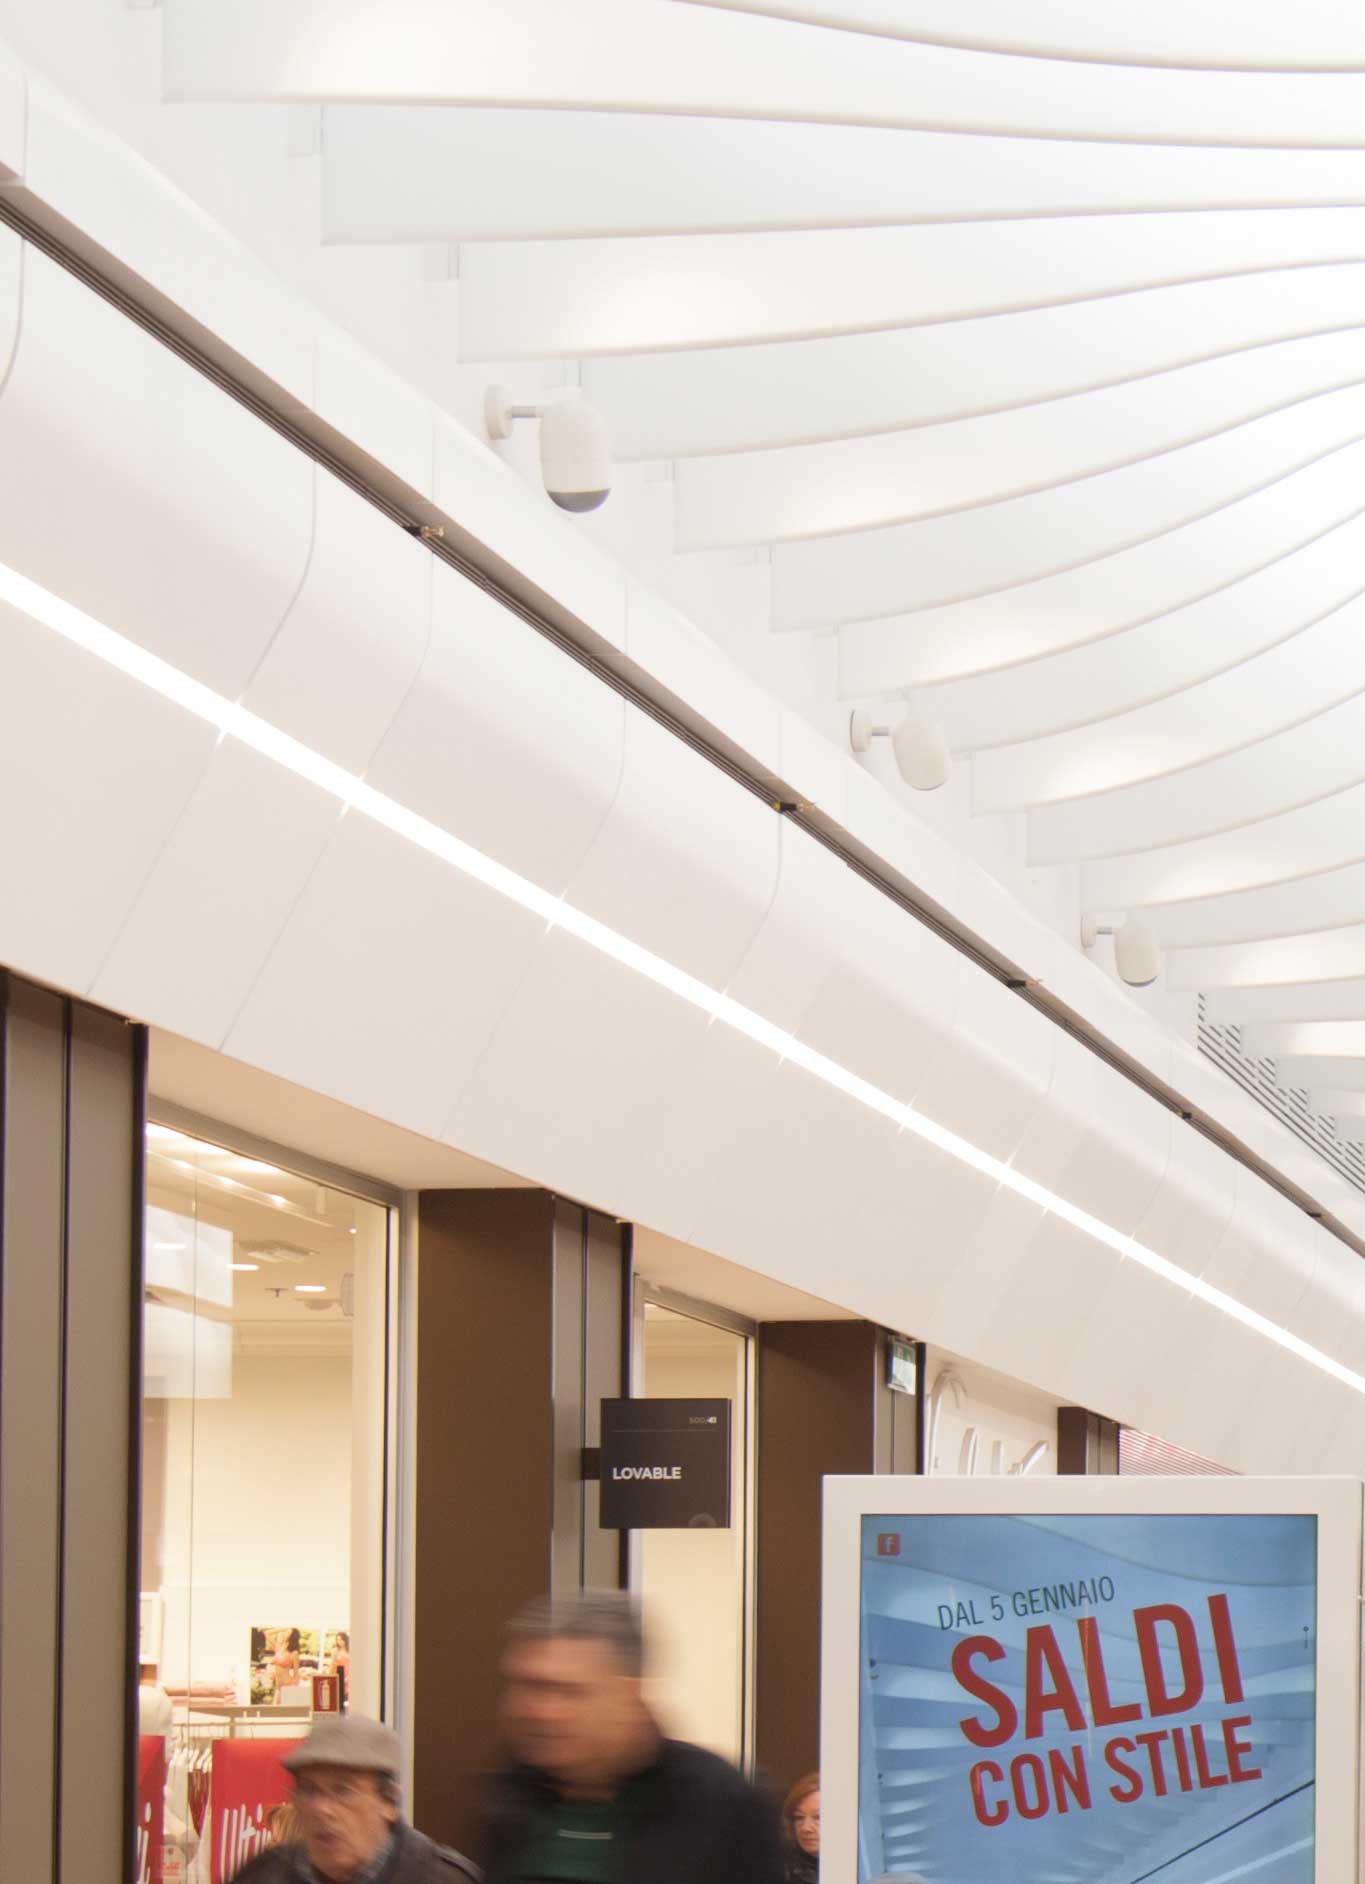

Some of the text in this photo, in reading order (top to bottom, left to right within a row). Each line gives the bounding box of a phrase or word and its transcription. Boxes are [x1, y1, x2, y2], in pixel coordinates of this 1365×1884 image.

[612, 1466, 682, 1480] LOVABLE
[937, 1576, 1115, 1631] DAL 5 GENNAIO
[951, 1593, 1244, 1748] SALDI
[969, 1715, 1262, 1827] CON STILE
